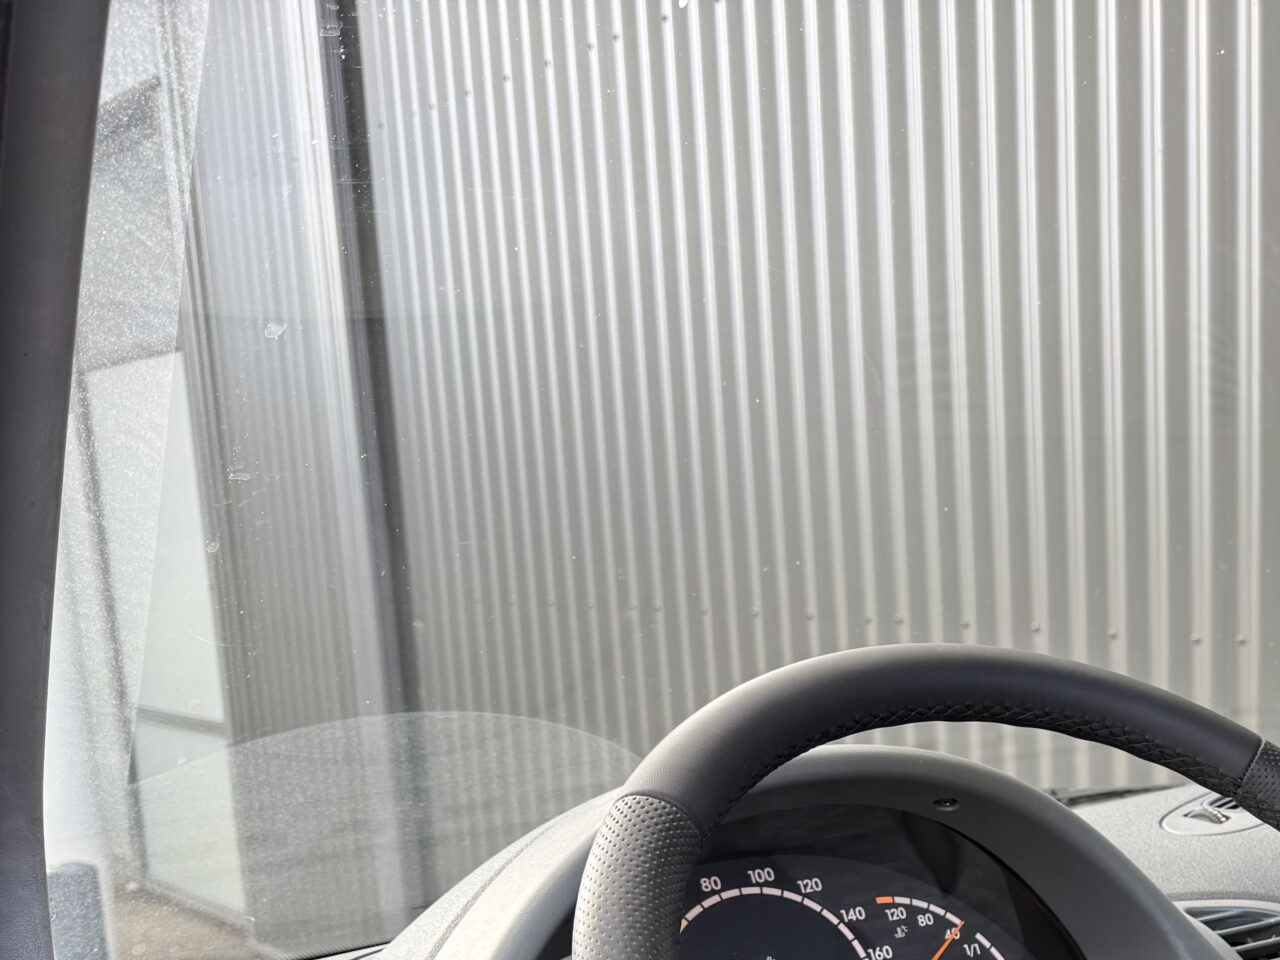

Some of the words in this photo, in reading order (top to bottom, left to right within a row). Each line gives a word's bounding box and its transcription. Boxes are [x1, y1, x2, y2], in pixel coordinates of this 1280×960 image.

[747, 867, 775, 884] 100
[700, 876, 722, 892] 80
[797, 878, 823, 894] 120
[840, 906, 866, 923] 140
[885, 907, 908, 922] 120
[917, 913, 935, 927] 80
[963, 943, 981, 958] 1/1
